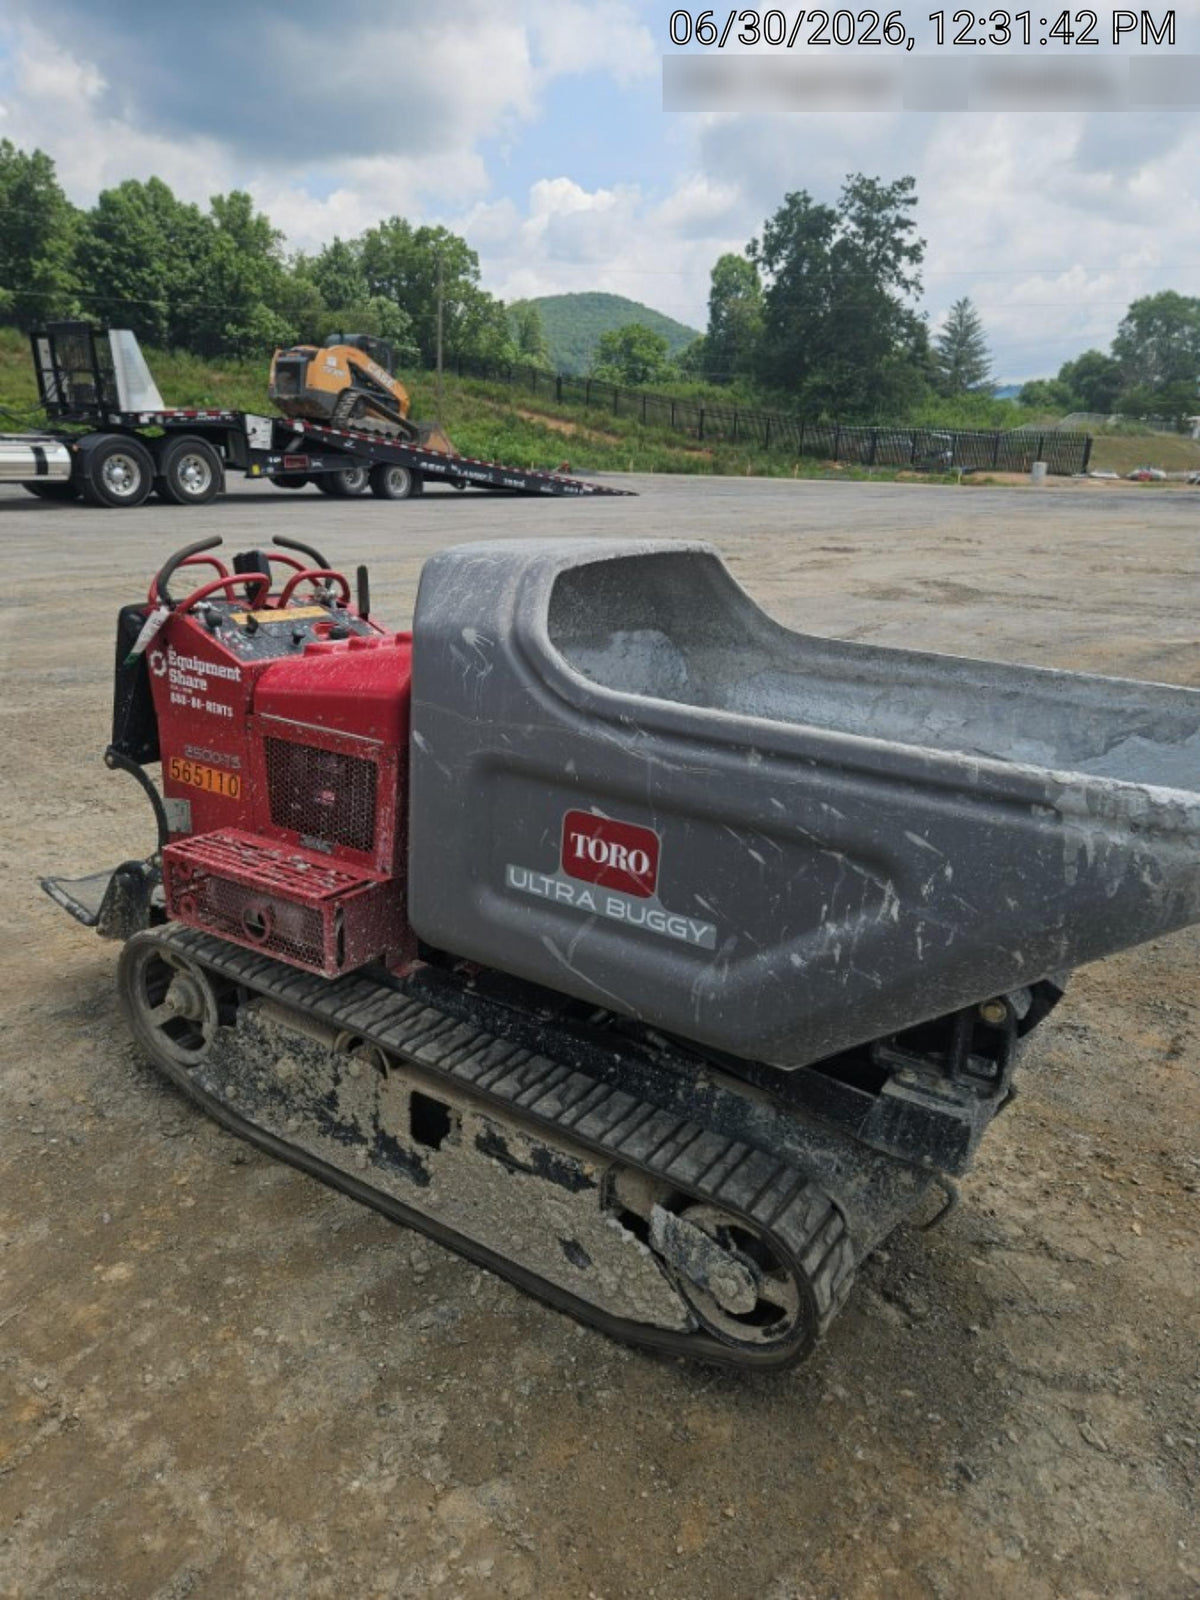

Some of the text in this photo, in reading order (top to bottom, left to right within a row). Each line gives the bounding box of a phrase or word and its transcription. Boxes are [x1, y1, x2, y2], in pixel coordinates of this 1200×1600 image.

[168, 650, 241, 681] Equipment
[168, 668, 208, 691] Share
[171, 758, 239, 796] 565110
[570, 832, 651, 875] TORO
[509, 868, 709, 943] ULTRA BUGGY
